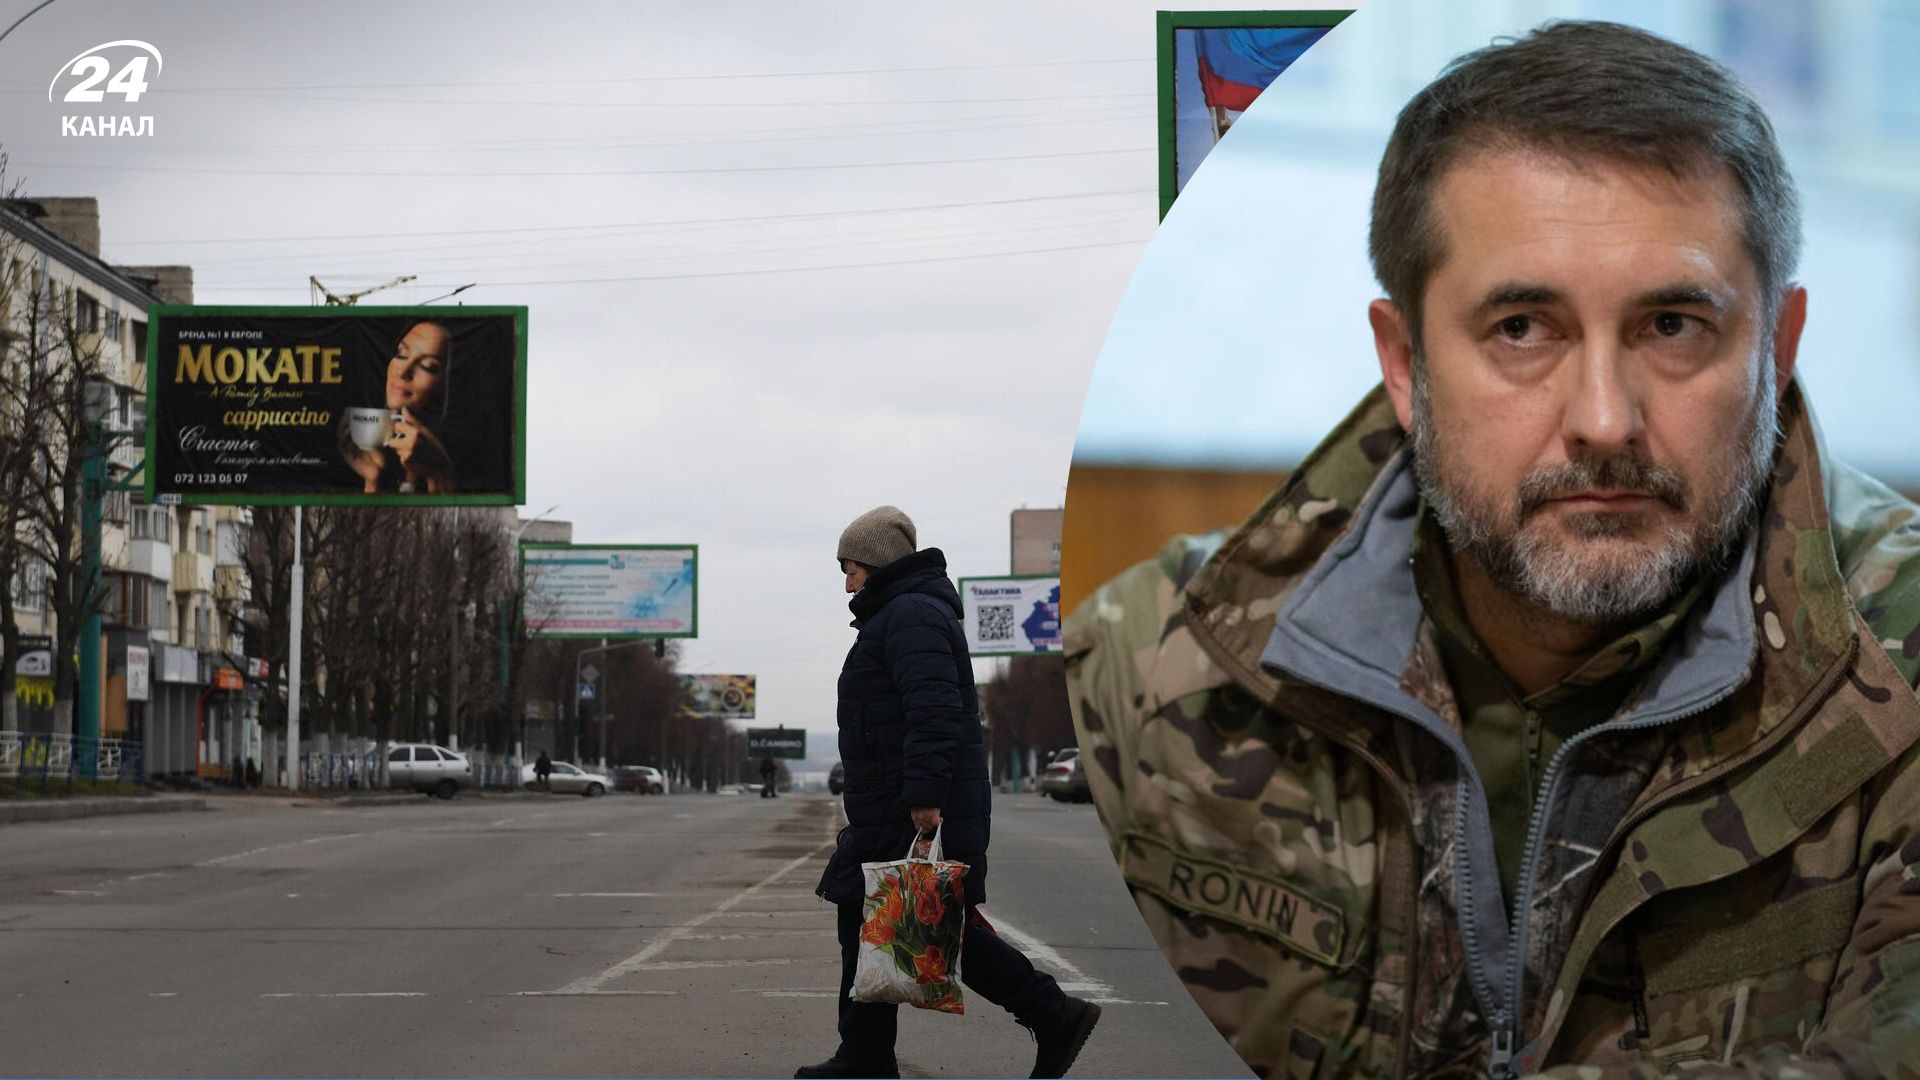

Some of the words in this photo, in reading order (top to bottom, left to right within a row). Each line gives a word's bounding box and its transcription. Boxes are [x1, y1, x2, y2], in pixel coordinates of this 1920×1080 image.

[179, 330, 206, 339] БРЕНД
[231, 331, 263, 339] ЕВРОПЕ
[175, 344, 343, 384] MOKATE
[223, 407, 331, 431] cappuccino
[179, 425, 260, 451] Счастье
[175, 473, 194, 484] 072
[199, 473, 216, 484] 123
[219, 473, 232, 484] 05
[235, 473, 248, 484] 07
[1168, 862, 1298, 935] RONIN
